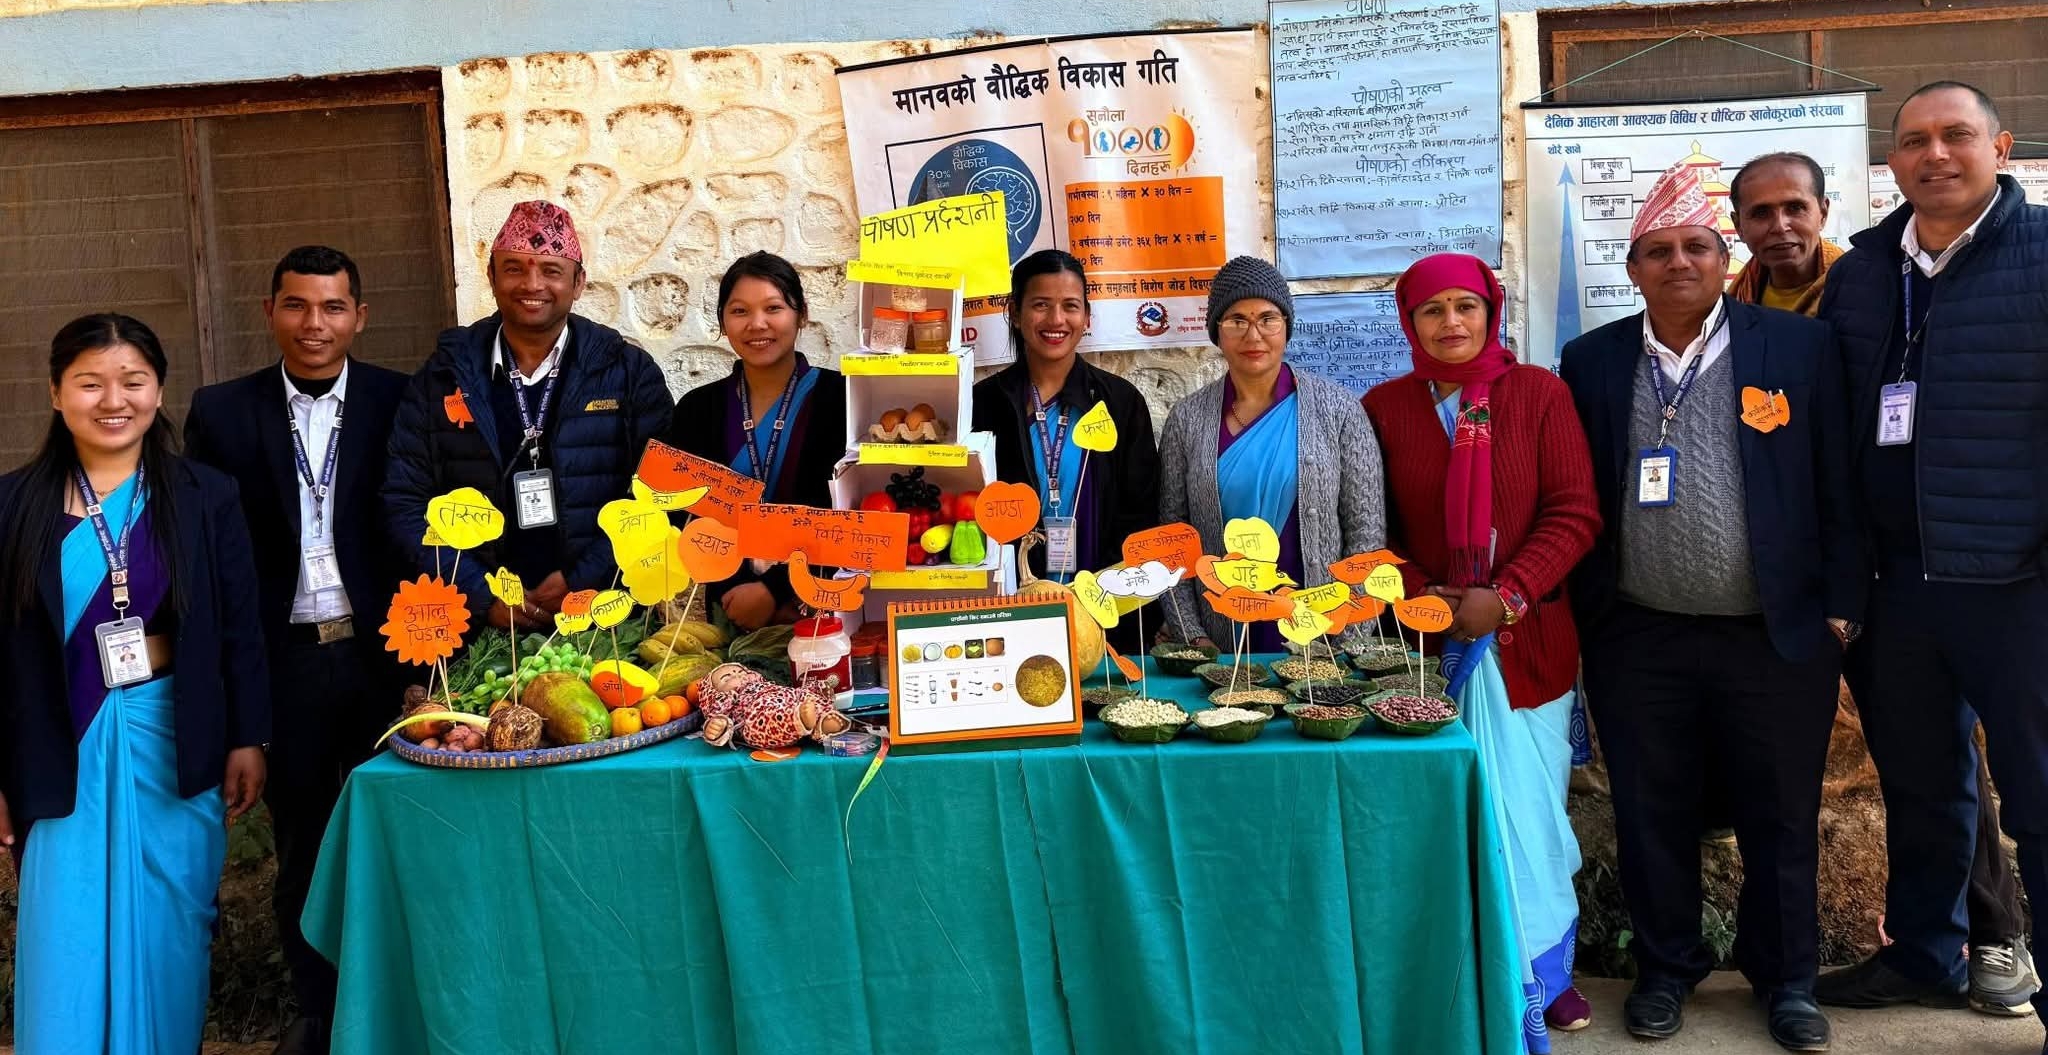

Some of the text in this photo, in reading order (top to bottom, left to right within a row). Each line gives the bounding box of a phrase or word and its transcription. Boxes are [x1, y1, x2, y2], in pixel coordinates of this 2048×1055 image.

[892, 74, 976, 114] मानवको
[1057, 56, 1127, 92] विकास
[1136, 49, 1179, 85] गति
[1351, 80, 1404, 104] पोषणको
[1086, 106, 1126, 126] सुनौला
[1544, 113, 1574, 129] दैनिक
[1577, 115, 1619, 128] आहारमा
[1622, 113, 1667, 127] आवश्यक
[1669, 109, 1698, 124] विविध
[1700, 112, 1708, 123] र
[1711, 107, 1746, 122] पौष्टिक
[1749, 104, 1806, 122] खानेकुराको
[952, 157, 988, 170] विकास
[1356, 153, 1408, 174] पोषणको
[928, 170, 951, 179] 30%
[1168, 185, 1182, 196] दिन
[1087, 211, 1101, 223] दिन
[861, 211, 921, 244] पोषण
[1154, 234, 1168, 246] दिन
